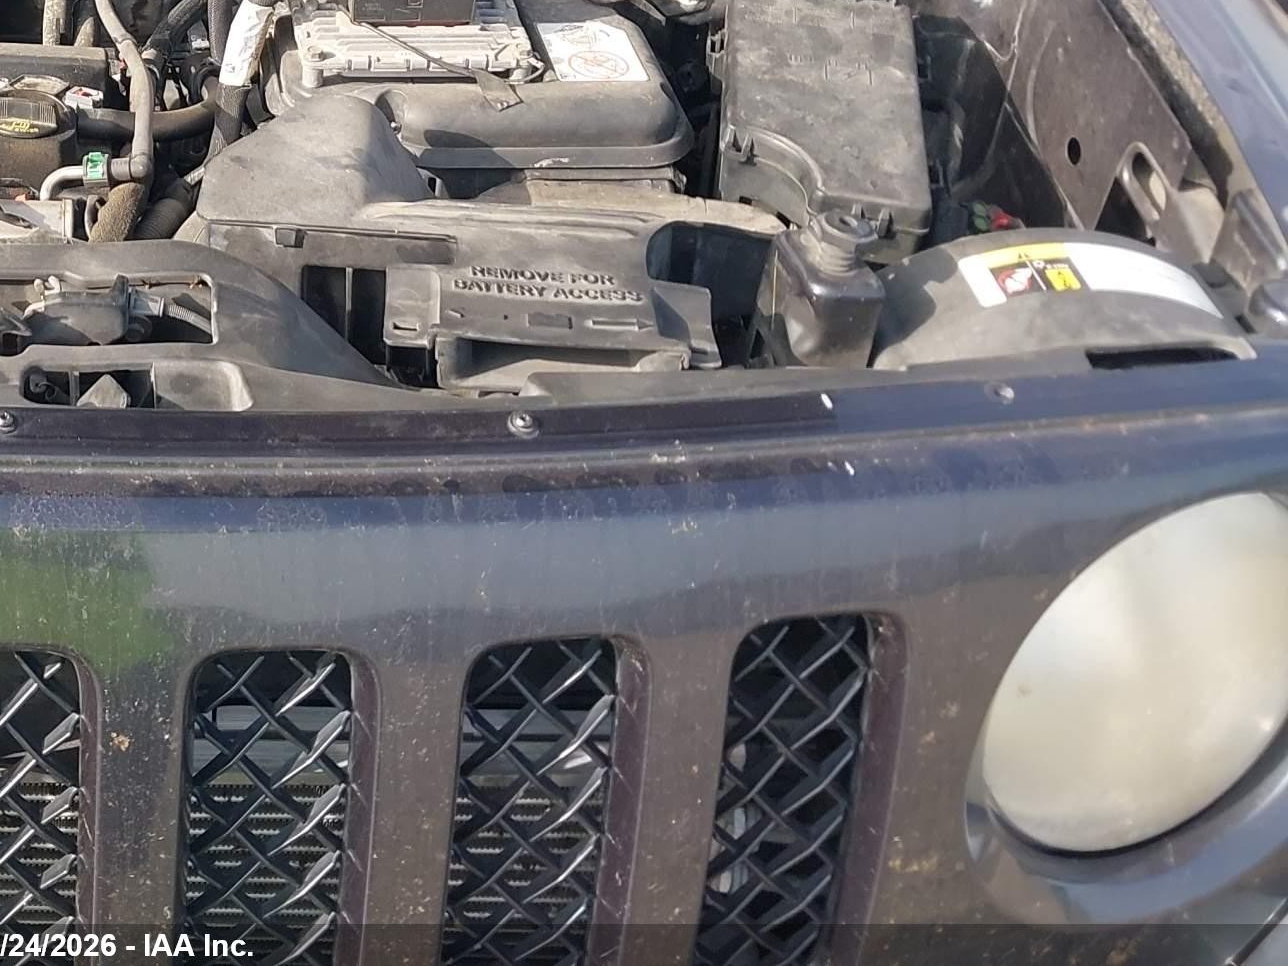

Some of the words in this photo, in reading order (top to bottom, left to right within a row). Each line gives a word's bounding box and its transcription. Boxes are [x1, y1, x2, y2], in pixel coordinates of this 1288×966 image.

[470, 265, 564, 283] REMOVE
[568, 272, 616, 285] FOR
[453, 278, 547, 298] BATTERY
[551, 287, 645, 304] ACCESS
